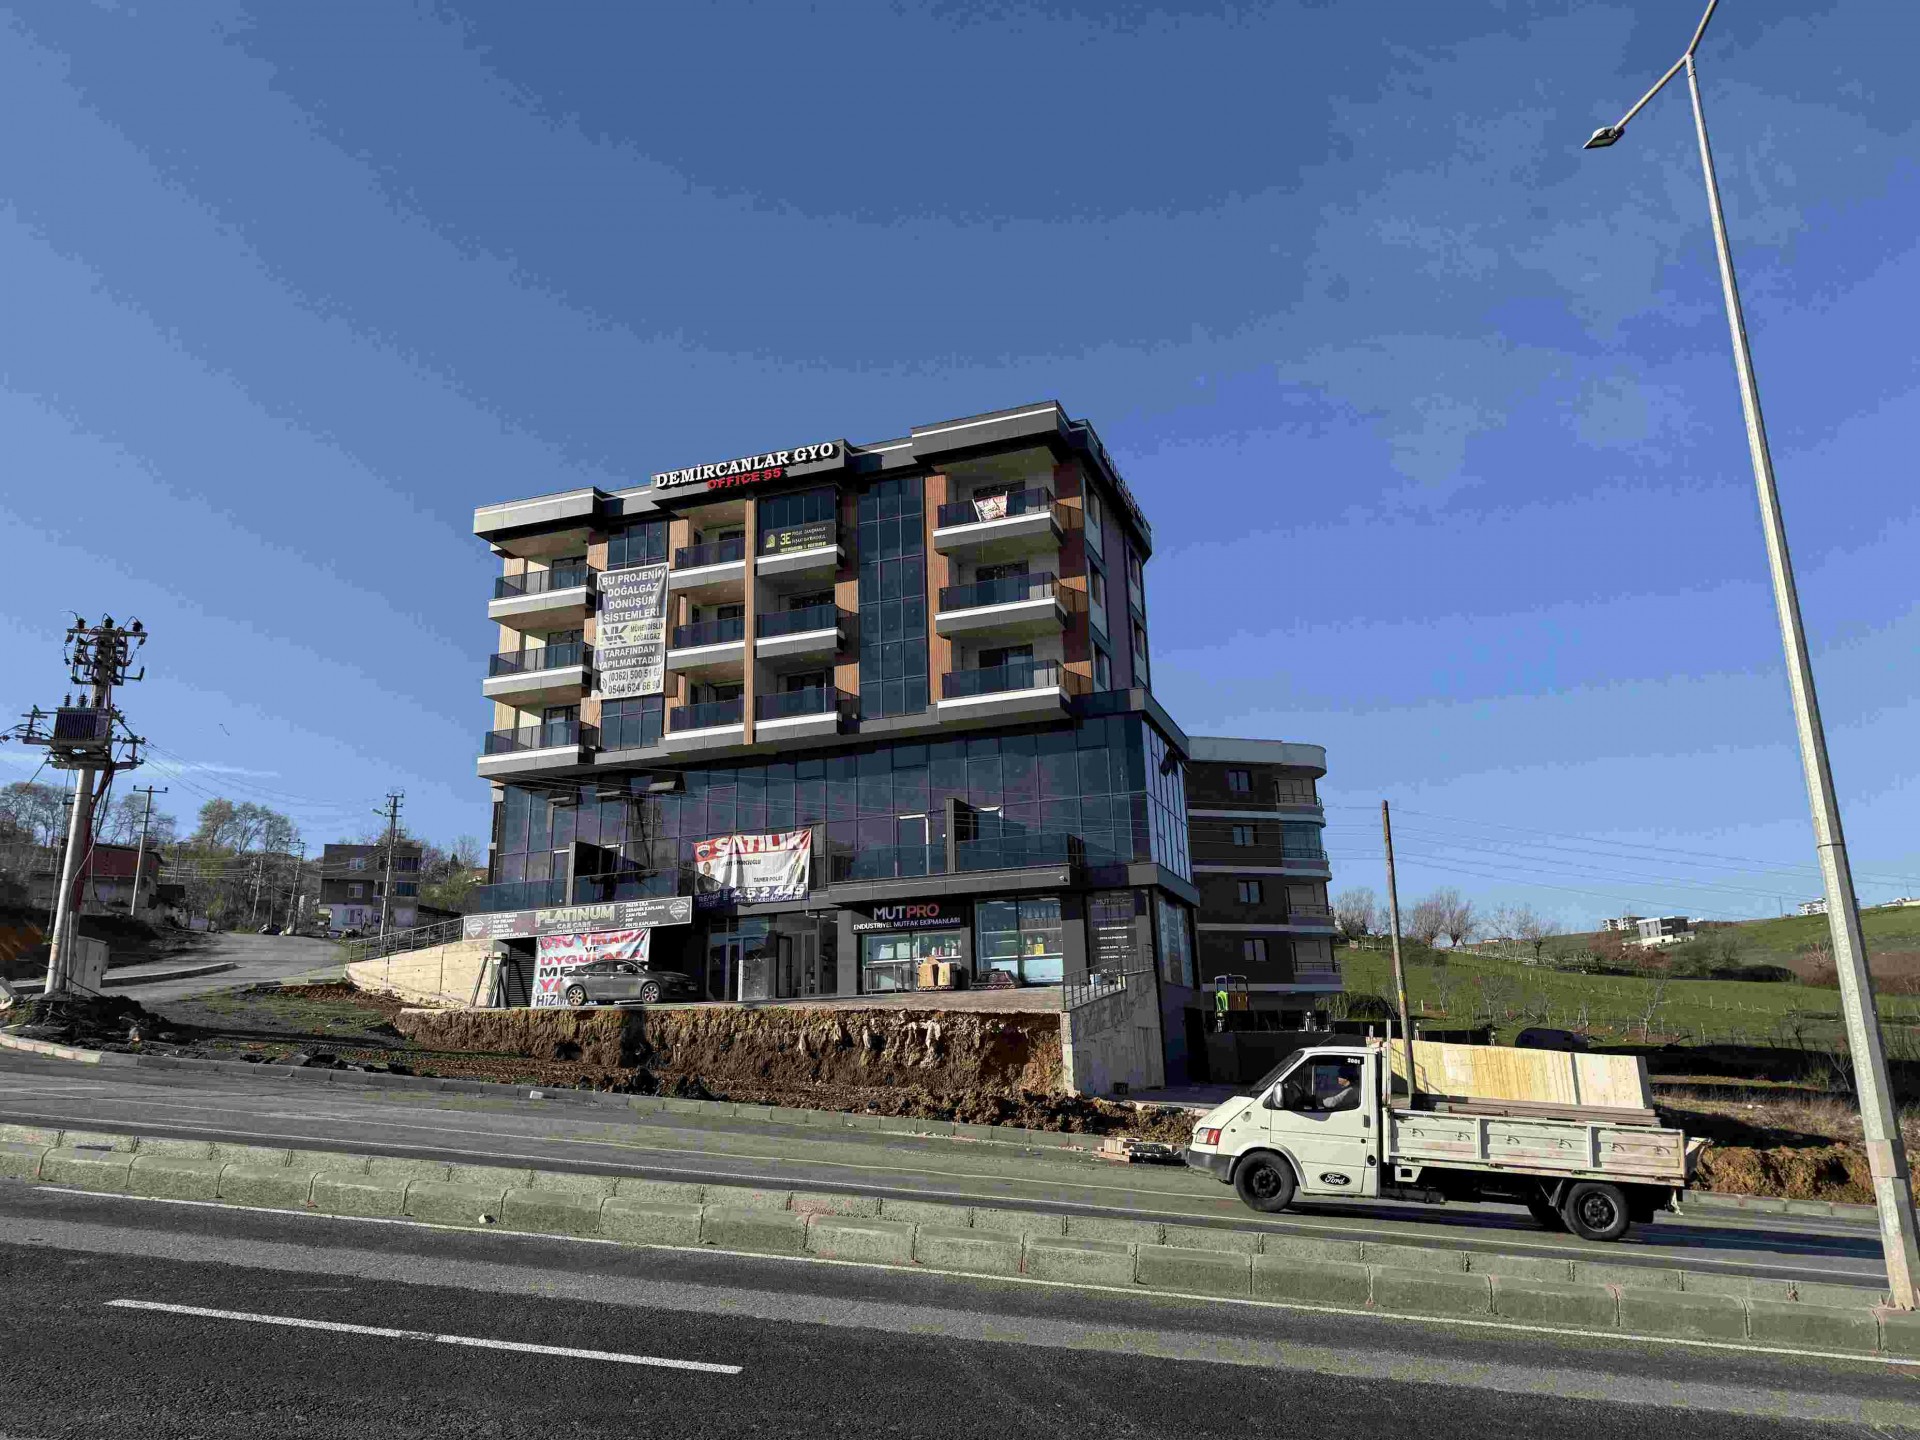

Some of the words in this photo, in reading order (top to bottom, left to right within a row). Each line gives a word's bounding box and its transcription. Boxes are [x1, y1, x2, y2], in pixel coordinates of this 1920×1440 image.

[656, 451, 789, 488] DEMİRCANLAR
[794, 442, 833, 462] GYO
[707, 471, 760, 489] OFFICE
[764, 467, 783, 481] 55
[780, 532, 791, 545] 3E
[602, 575, 615, 586] BU
[607, 582, 659, 598] DOĞALGAZ
[608, 595, 656, 610] DÖNÜŞÜM
[604, 606, 660, 623] SİSTEMLERİ
[605, 645, 655, 658] TARAFINDAN
[598, 655, 662, 670] YAPILMAKTADIR
[608, 671, 628, 684] (0362)
[630, 669, 643, 680] 500
[608, 684, 625, 695] 0544
[627, 682, 640, 693] 624
[642, 681, 651, 691] 66
[715, 832, 802, 857] SATILIK
[535, 905, 615, 927] PLATINUM
[873, 903, 940, 920] MUTPRO
[893, 919, 919, 928] MUTFAK
[1325, 1173, 1346, 1184] Ford
